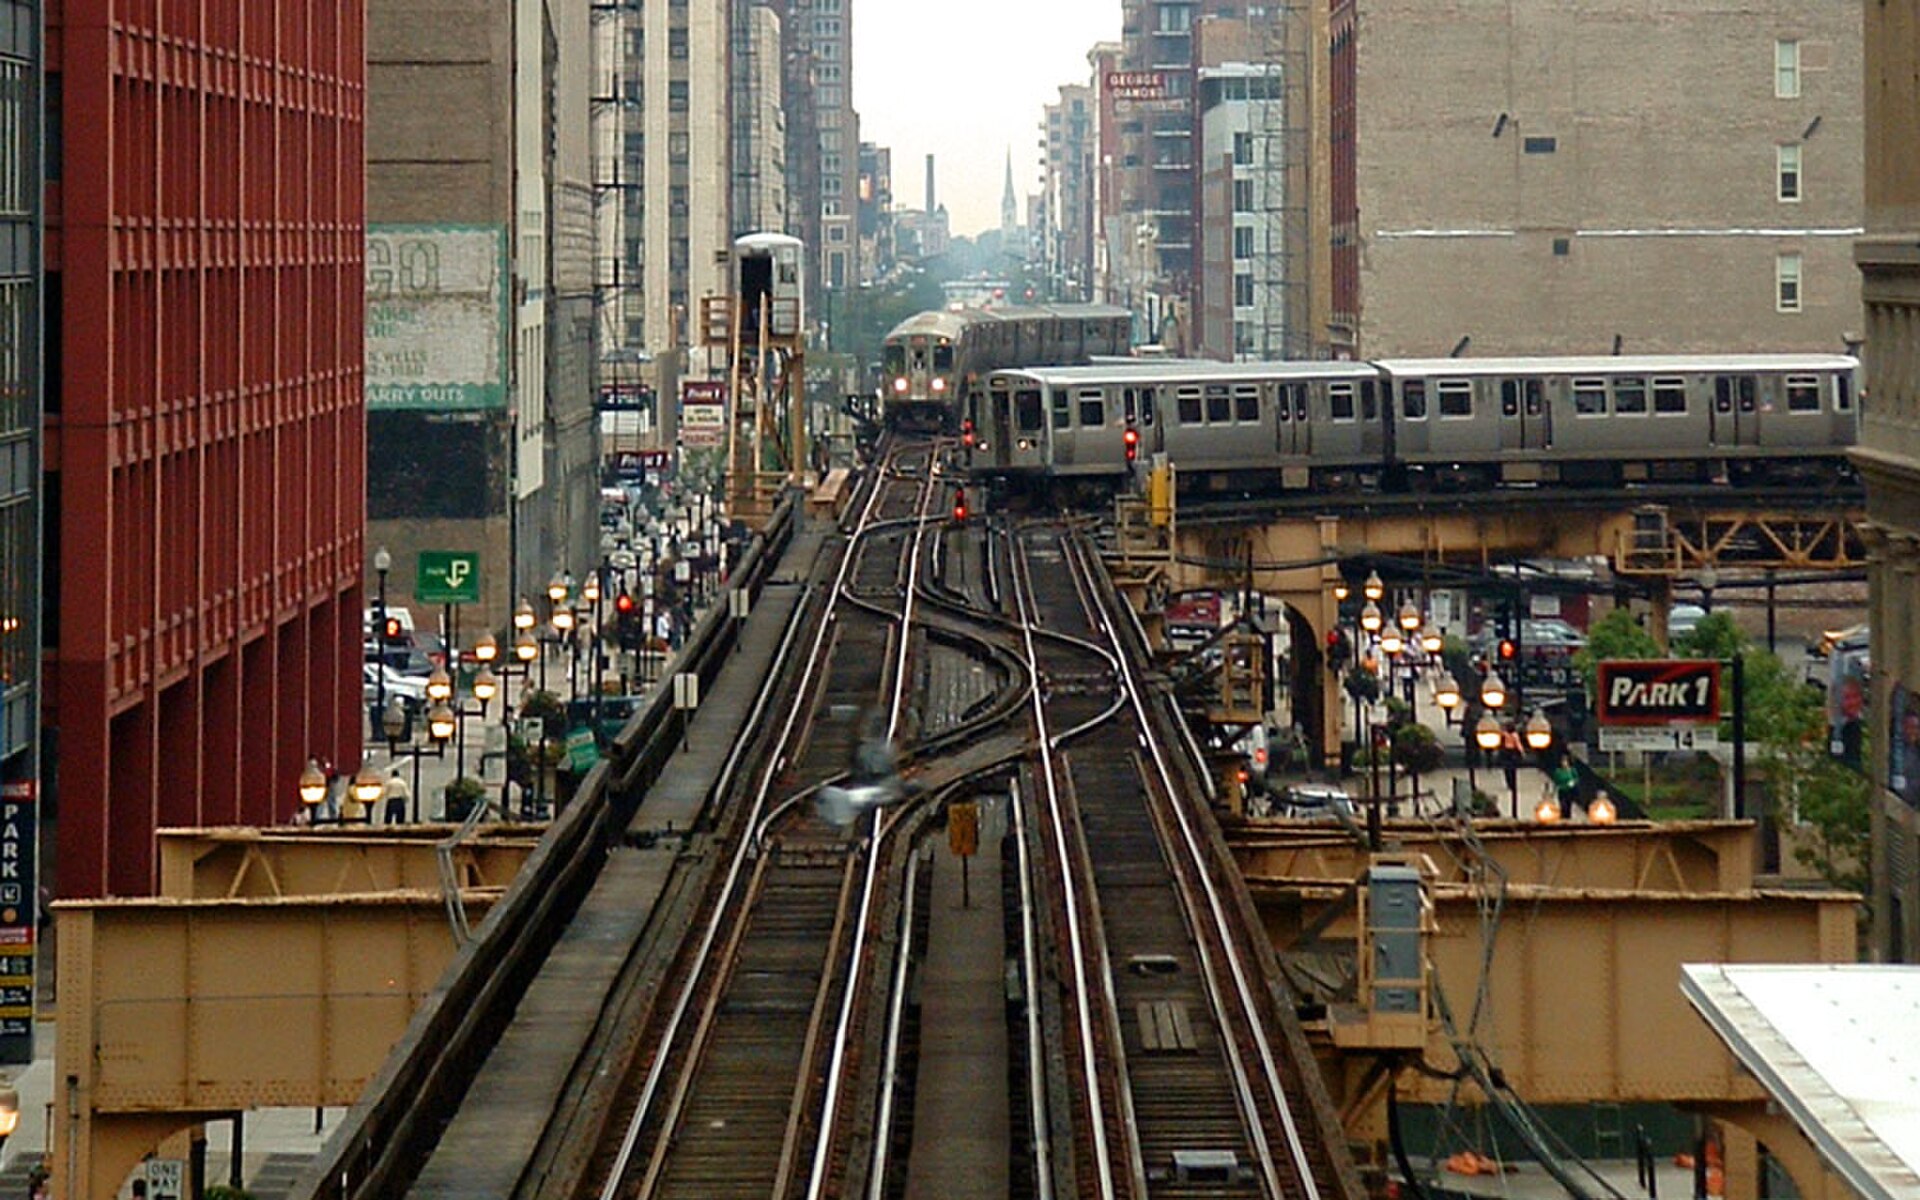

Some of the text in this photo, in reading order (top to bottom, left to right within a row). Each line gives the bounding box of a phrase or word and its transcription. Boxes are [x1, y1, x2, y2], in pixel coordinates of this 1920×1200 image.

[1109, 73, 1164, 86] GEORGE
[1112, 86, 1165, 99] DIAMOND
[420, 388, 465, 402] OUTS
[1609, 676, 1710, 707] PARK 1
[1674, 730, 1694, 751] 14
[2, 803, 19, 879] PARK
[151, 1163, 178, 1176] ONE
[151, 1178, 179, 1189] WAY
